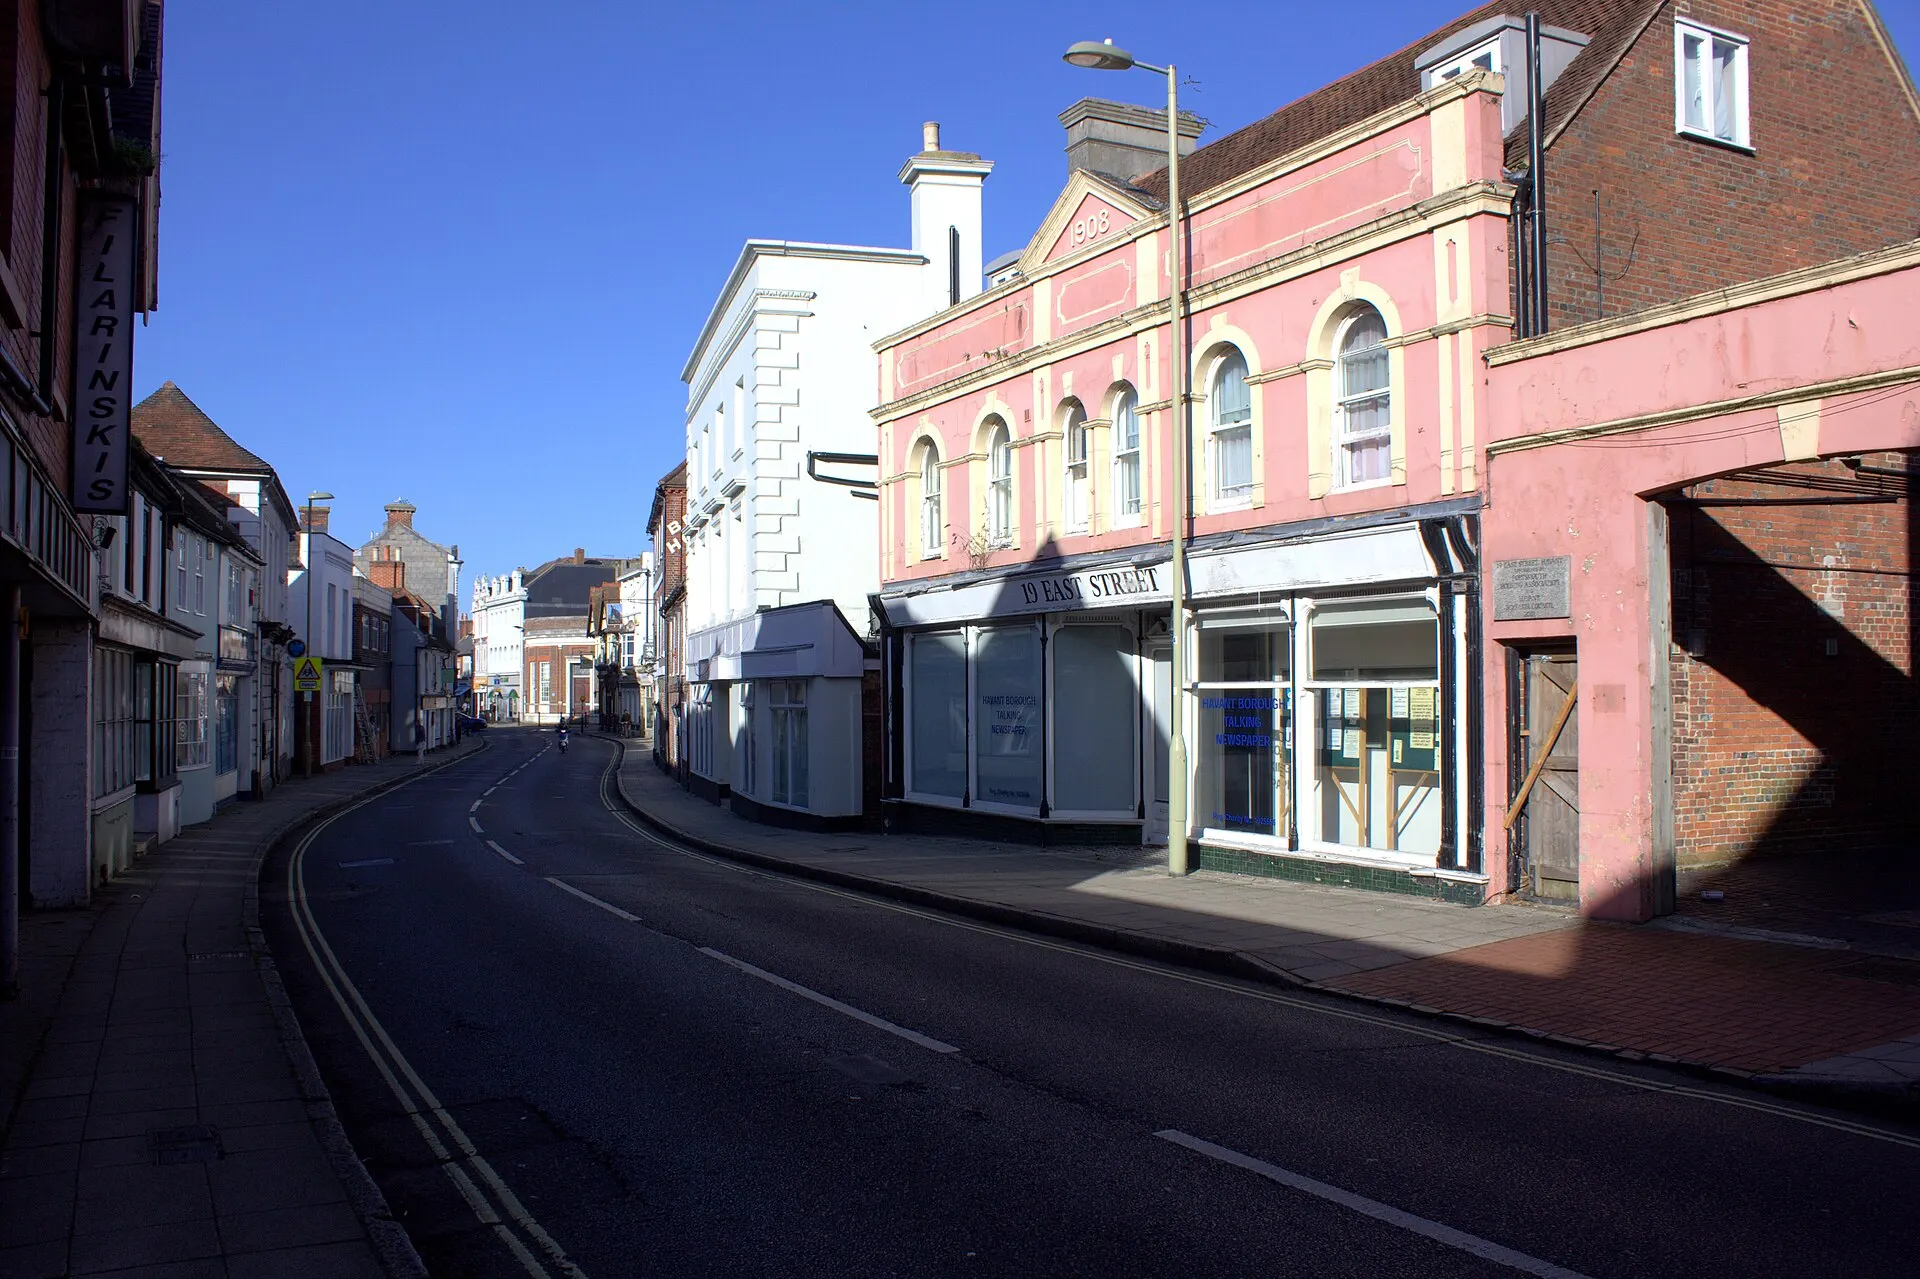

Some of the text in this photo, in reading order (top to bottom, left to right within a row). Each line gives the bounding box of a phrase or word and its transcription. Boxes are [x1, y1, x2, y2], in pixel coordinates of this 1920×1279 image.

[1070, 208, 1110, 248] 1908
[86, 206, 124, 501] FILARINSKIS
[1021, 567, 1160, 605] 19 EAST STREET
[982, 695, 1036, 706] HAVANT BOROUGH
[1202, 697, 1284, 710] HAVANT BOROUGH
[996, 710, 1021, 720] TALKING
[1224, 716, 1262, 728] TALKING
[991, 724, 1027, 736] NEWSPAPER
[1215, 734, 1271, 747] NEWSPAPER
